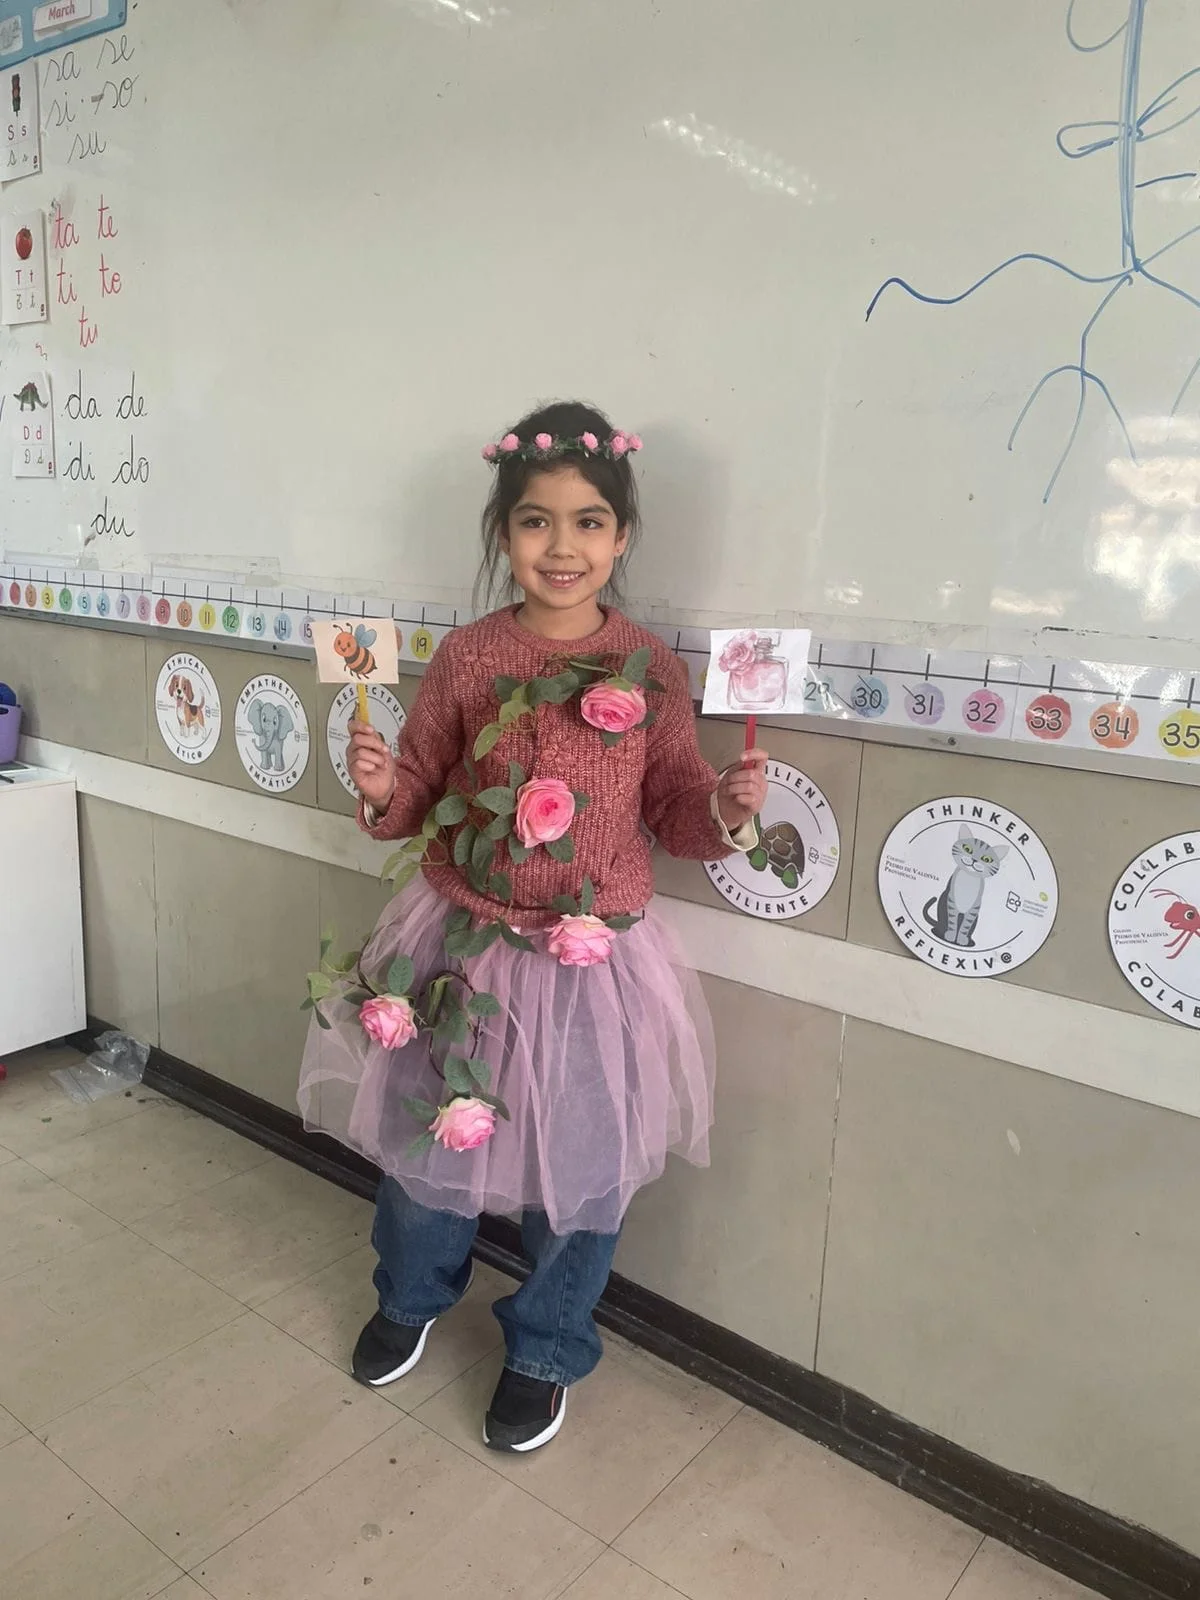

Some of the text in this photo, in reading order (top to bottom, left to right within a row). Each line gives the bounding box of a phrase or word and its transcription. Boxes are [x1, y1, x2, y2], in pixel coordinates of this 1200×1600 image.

[48, 3, 76, 21] March
[43, 35, 135, 88] sa se
[44, 75, 139, 129] si so
[7, 124, 27, 141] S s
[67, 131, 107, 164] su
[55, 194, 118, 249] ta te
[15, 269, 34, 285] T t
[56, 257, 77, 304] ti
[78, 305, 98, 348] tu
[65, 369, 148, 420] da de
[23, 425, 42, 440] D d
[63, 434, 149, 484] di do
[91, 496, 135, 537] du
[44, 592, 51, 605] 3
[82, 596, 88, 609] 5
[99, 597, 106, 611] 6
[120, 601, 125, 614] 7
[140, 601, 146, 615] 8
[160, 605, 166, 620] 9
[179, 607, 189, 622] 10
[204, 611, 211, 625] 11
[226, 613, 236, 628] 12
[252, 616, 263, 632] 13
[278, 620, 288, 634] 14
[303, 623, 313, 638] 15
[416, 637, 428, 653] 19
[855, 687, 883, 709] 30
[912, 694, 934, 716] 31
[966, 700, 998, 724] 32
[1030, 707, 1062, 731] 33
[1094, 714, 1130, 740] 34
[1163, 722, 1200, 749] 35
[167, 657, 204, 674] ETHICAL
[240, 679, 300, 709] EMPATHETIC
[336, 685, 405, 722] RESECTFUL
[249, 765, 298, 788] EMPÁTIC@
[765, 765, 825, 809] ILIENT
[927, 804, 1030, 846] THINKER
[709, 863, 808, 914] RESILIENTE
[894, 916, 1012, 970] REFLEXIV@
